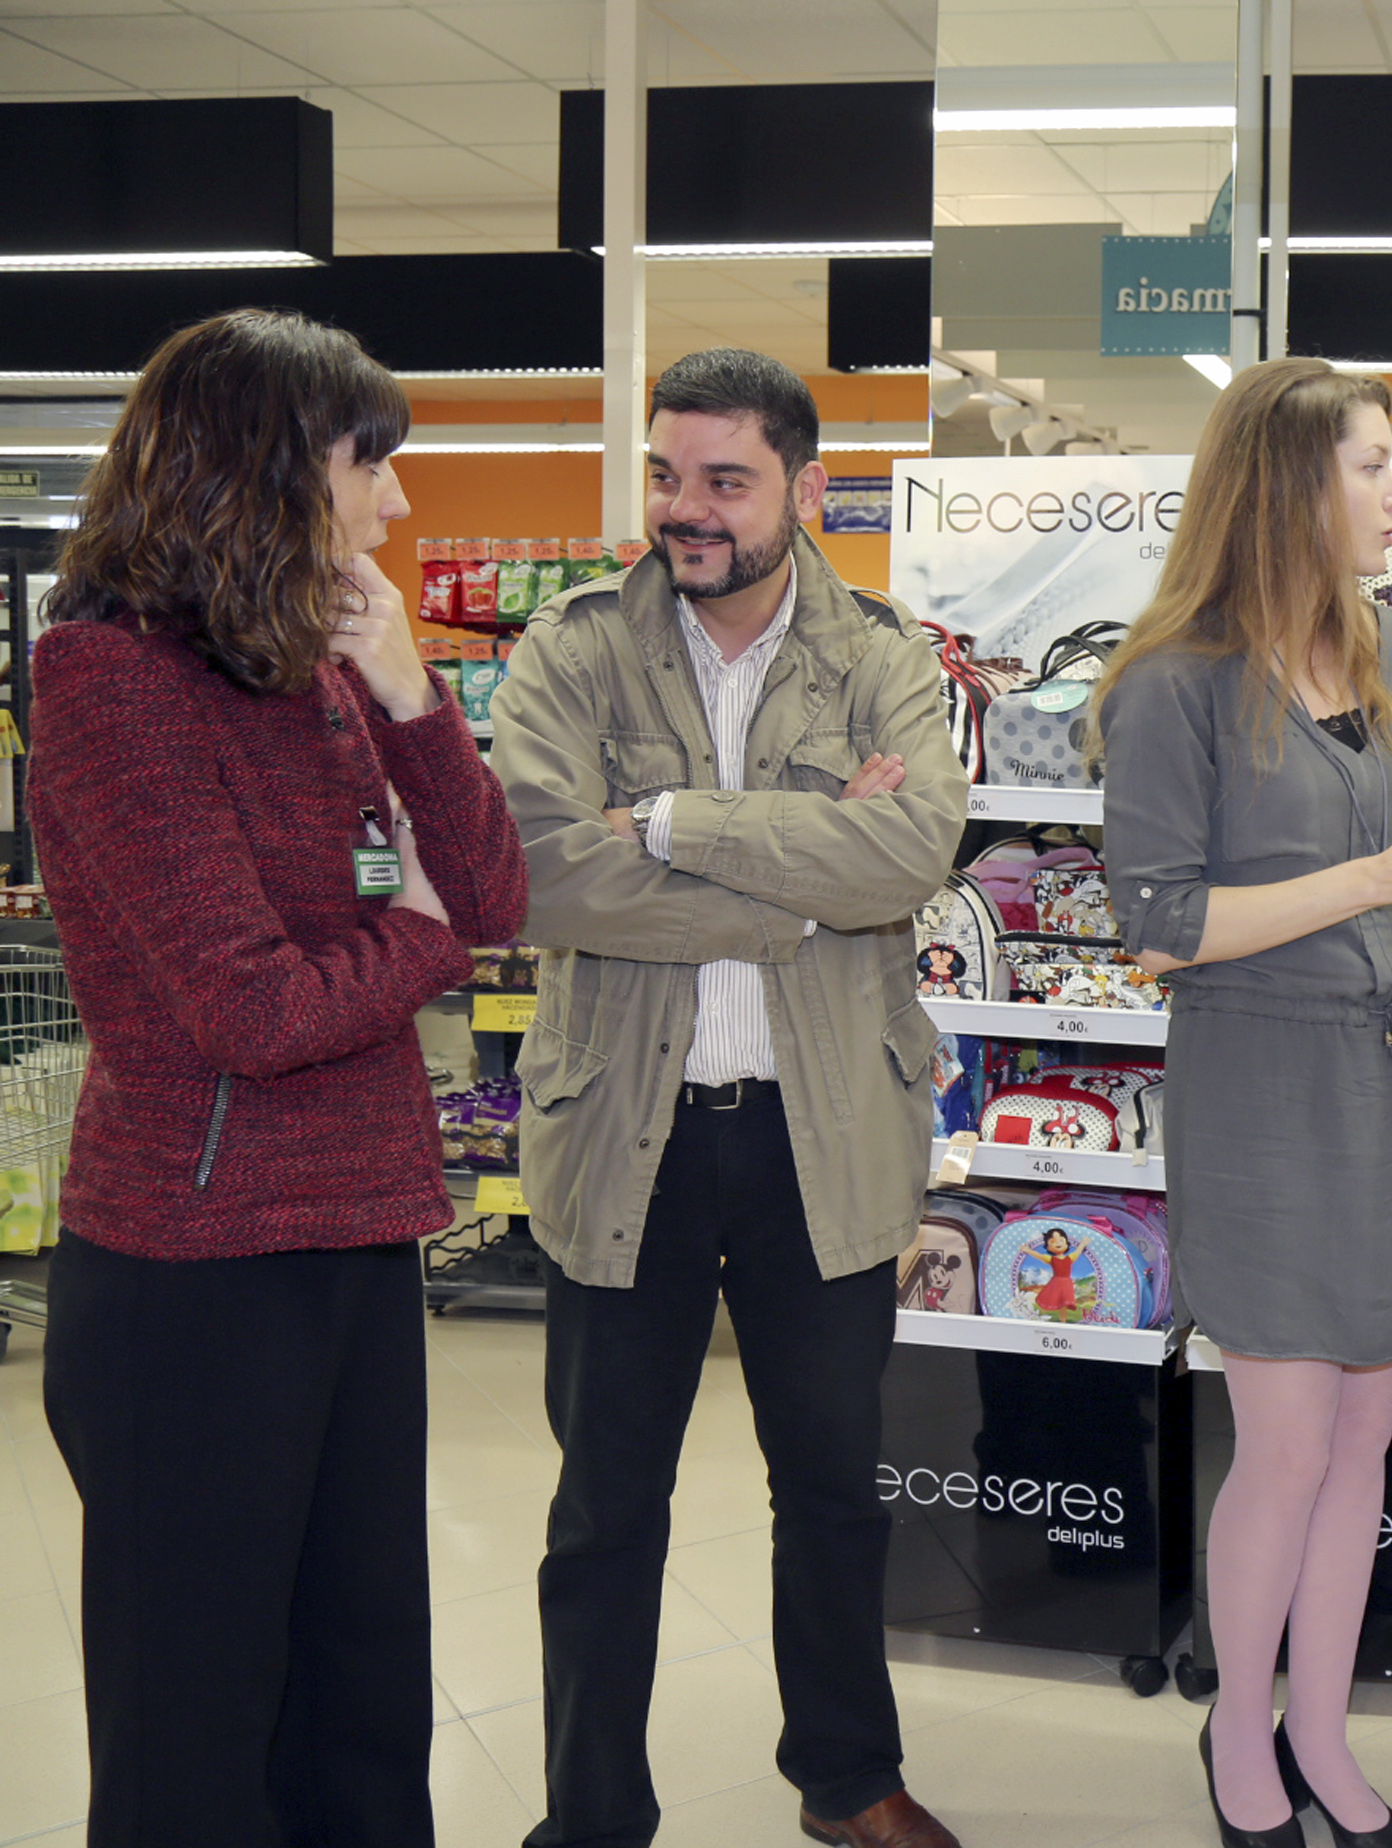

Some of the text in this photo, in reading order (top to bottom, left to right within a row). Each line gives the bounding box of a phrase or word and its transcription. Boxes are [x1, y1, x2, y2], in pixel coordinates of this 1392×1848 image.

[904, 476, 1186, 533] Necesere
[1010, 759, 1065, 781] Minnie
[876, 1463, 1125, 1524] eceseres
[1047, 1525, 1125, 1552] deliplus
